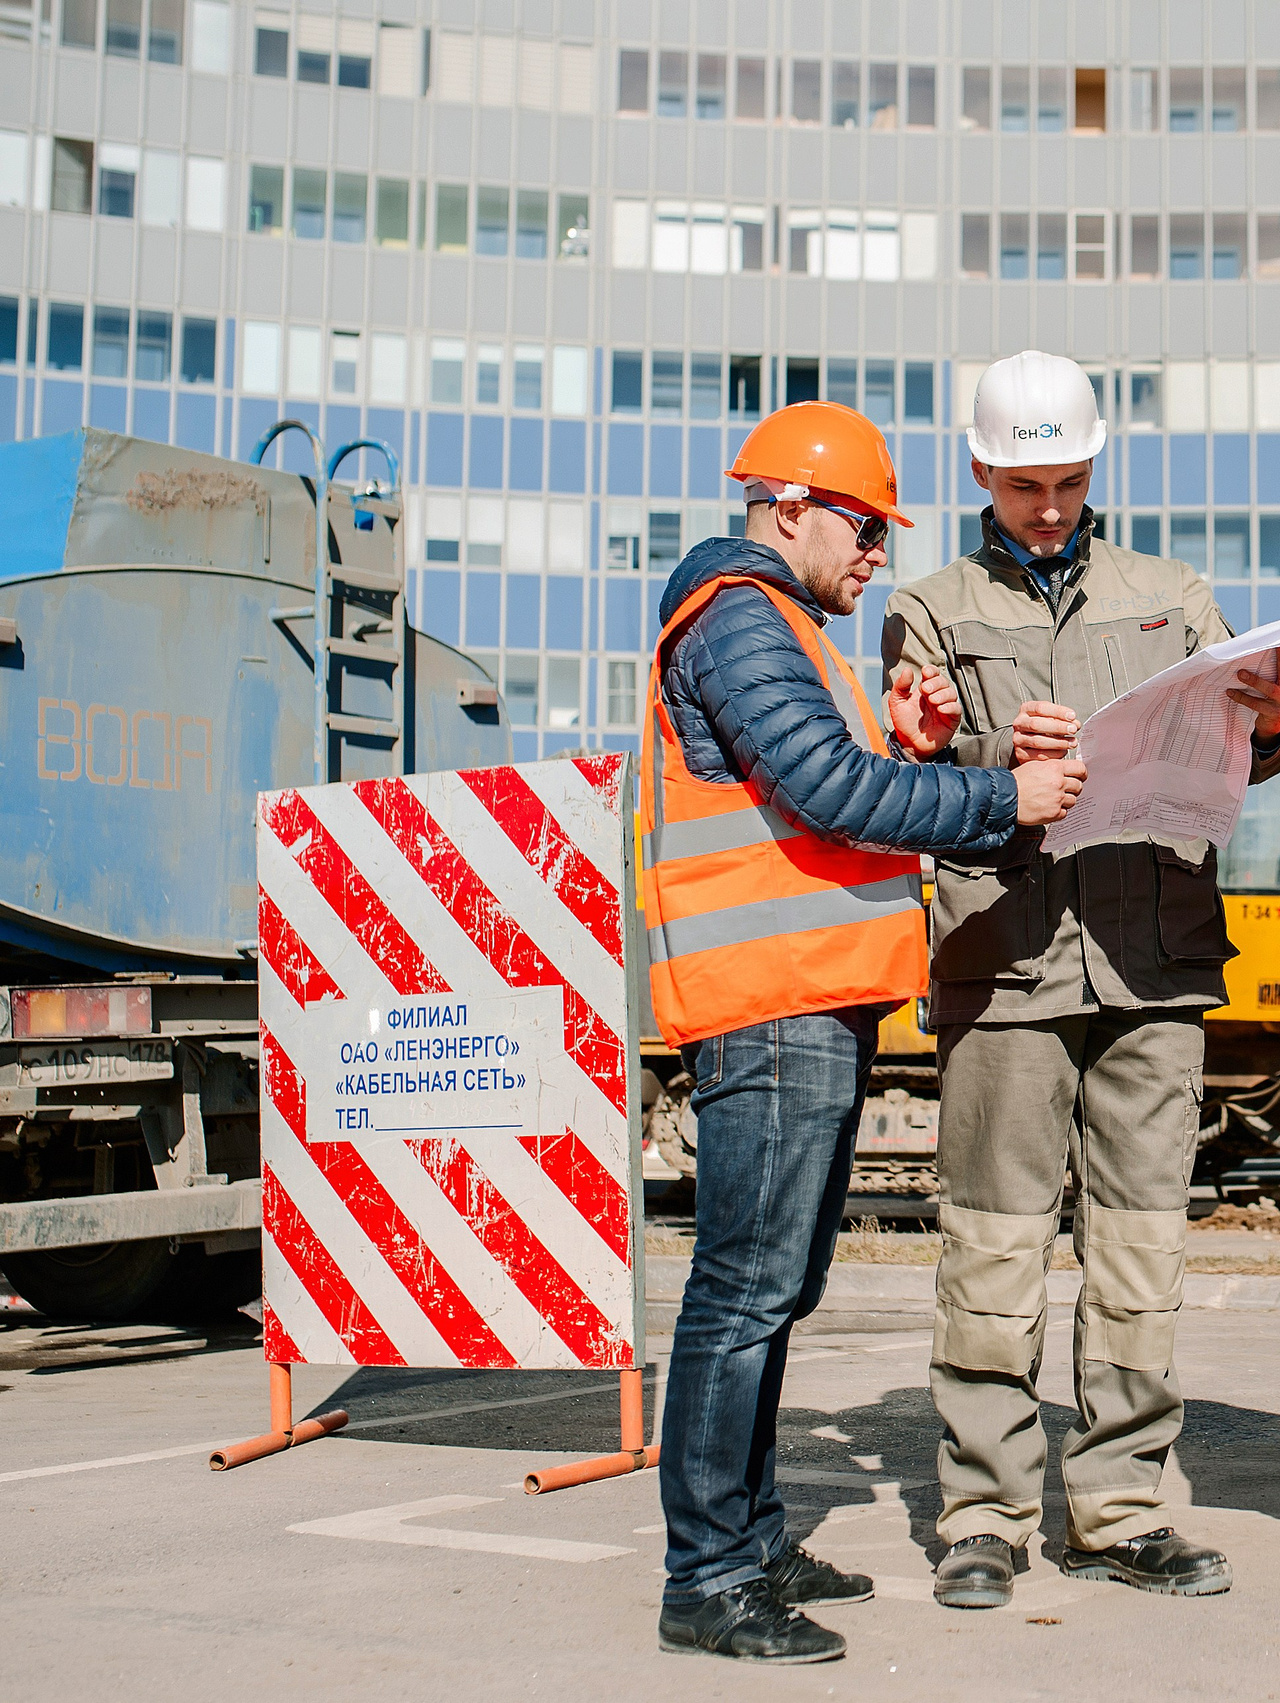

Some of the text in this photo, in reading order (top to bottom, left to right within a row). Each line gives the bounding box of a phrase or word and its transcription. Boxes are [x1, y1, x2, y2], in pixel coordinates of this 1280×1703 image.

[1011, 423, 1063, 440] ГенЭК
[37, 696, 212, 794] ВОДА
[387, 1004, 468, 1030] ФИЛИАЛ
[340, 1034, 521, 1064] ОАО «ЛЕНЭНЕРГО»
[335, 1067, 526, 1096] «КАБЕЛЬНАЯ СЕТЬ»
[335, 1107, 375, 1130] ТЕЛ.
